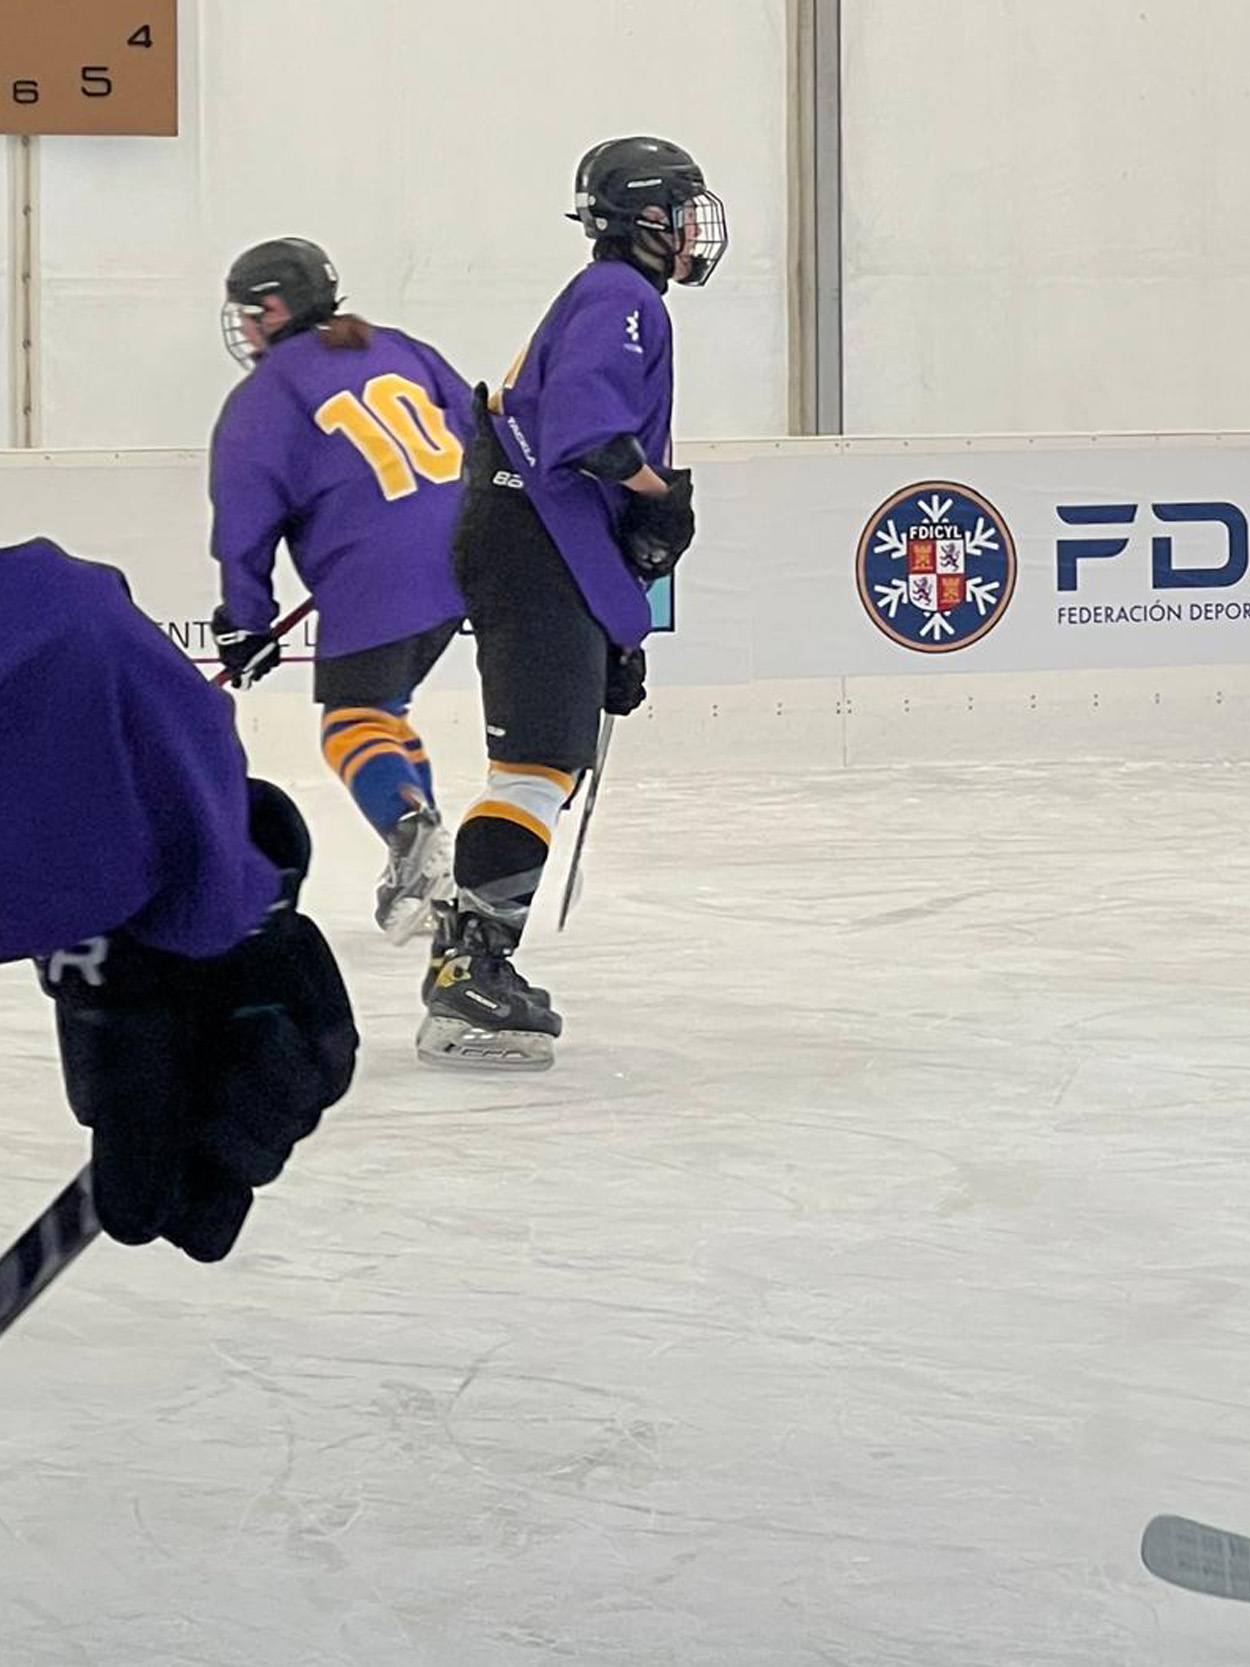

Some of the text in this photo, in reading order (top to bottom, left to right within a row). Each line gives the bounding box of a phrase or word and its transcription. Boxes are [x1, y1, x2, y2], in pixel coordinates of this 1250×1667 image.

[127, 24, 153, 48] 4
[13, 80, 39, 104] 6
[81, 66, 112, 97] 5
[314, 373, 464, 501] 10
[908, 525, 963, 540] FDICYL
[1057, 599, 1182, 625] FEDERACIÓN
